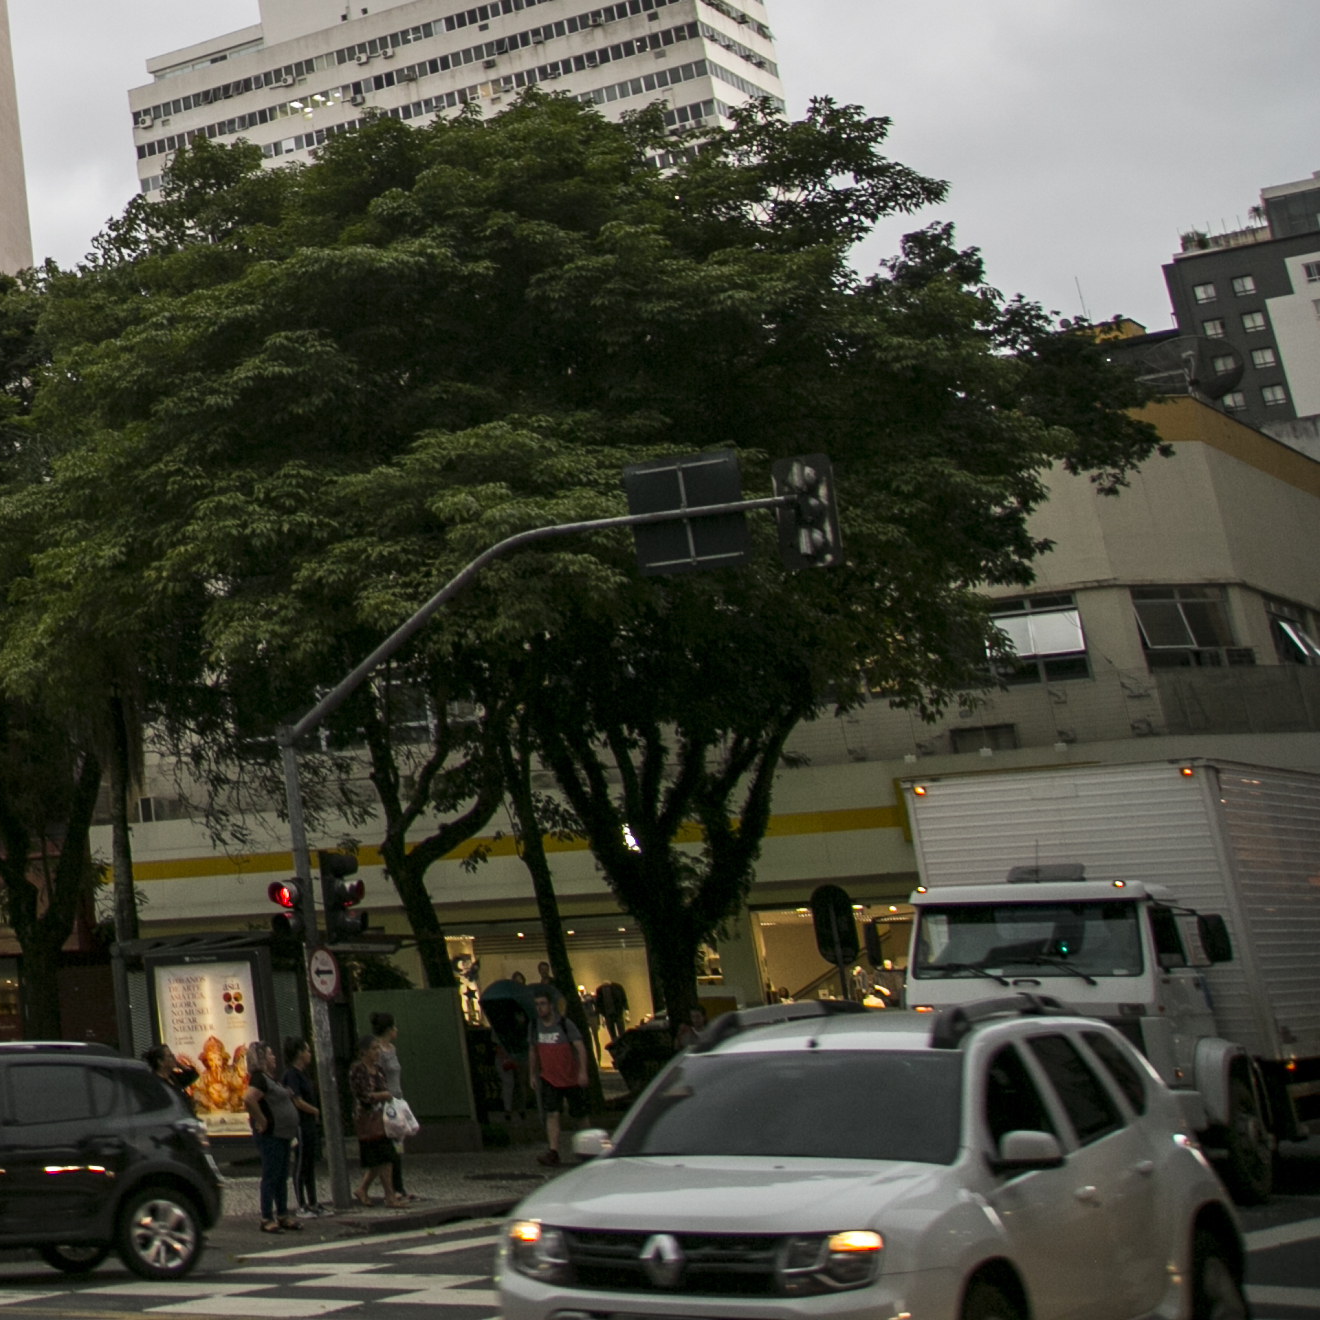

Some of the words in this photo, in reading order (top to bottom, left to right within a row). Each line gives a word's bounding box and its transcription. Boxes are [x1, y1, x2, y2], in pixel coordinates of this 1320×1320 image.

[168, 985, 179, 993] DE
[171, 1009, 183, 1017] NO
[184, 1007, 211, 1016] MUSEU
[172, 1017, 197, 1025] OSCAR
[173, 1024, 216, 1033] NIEMEYER
